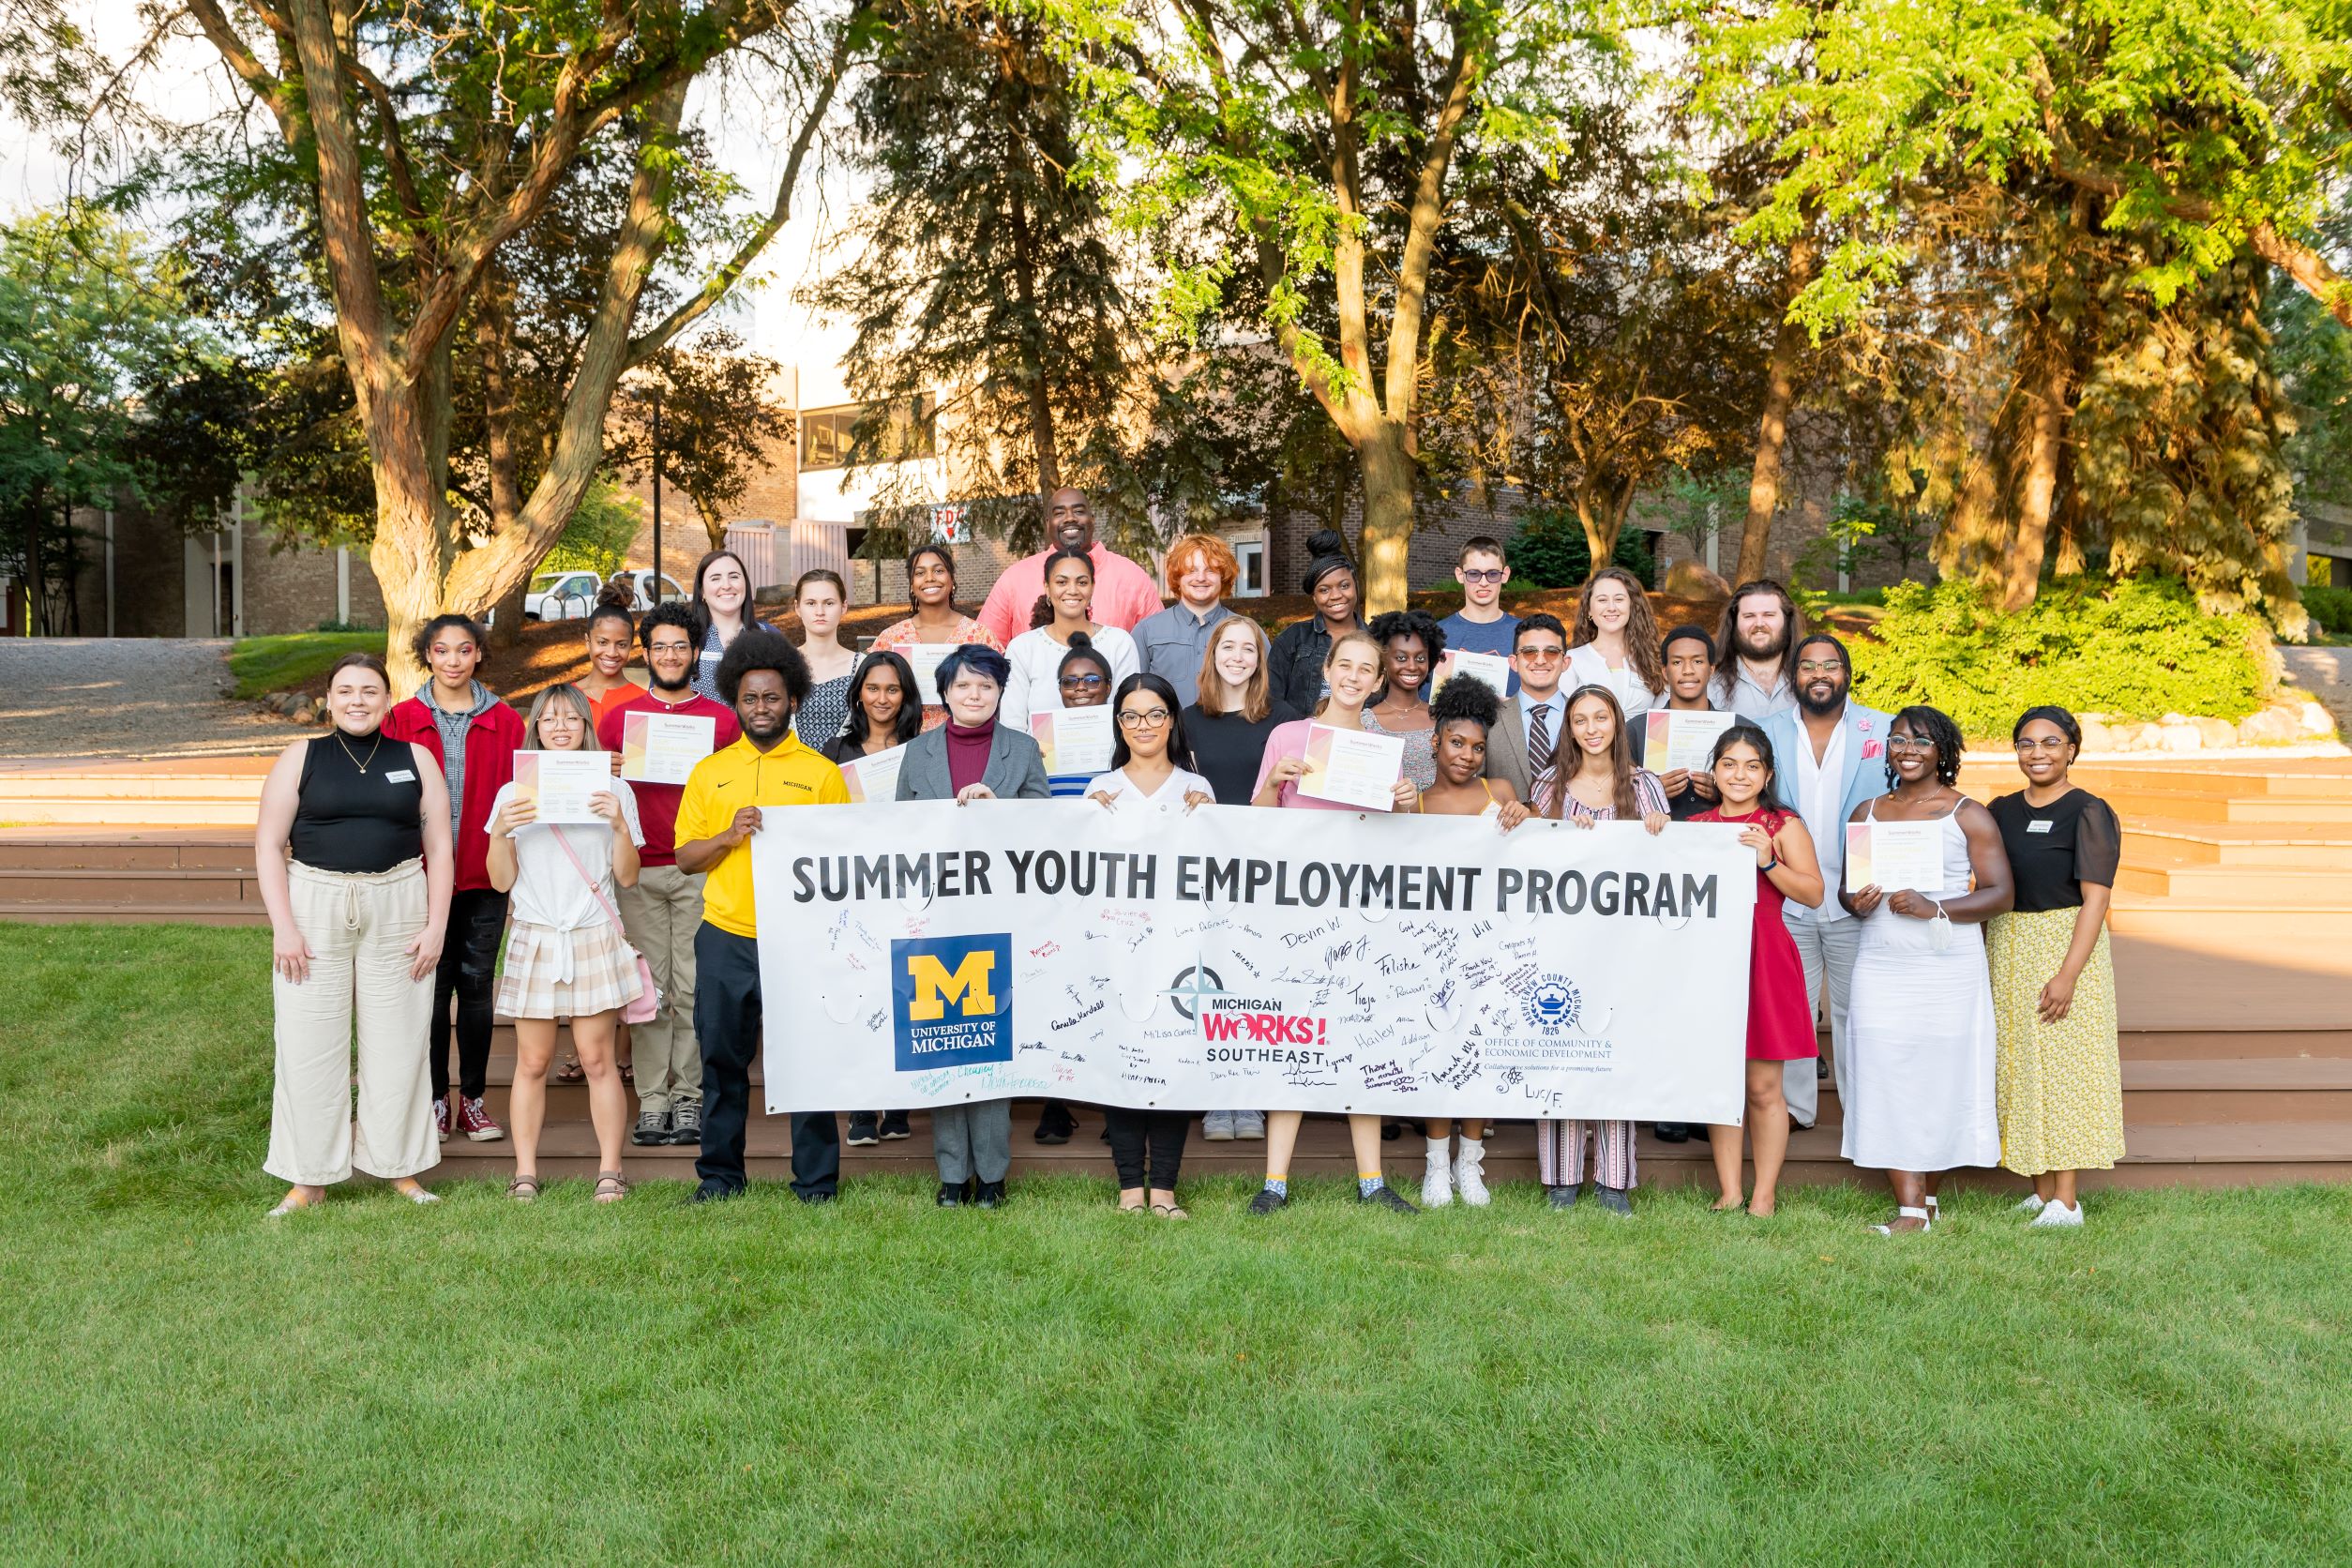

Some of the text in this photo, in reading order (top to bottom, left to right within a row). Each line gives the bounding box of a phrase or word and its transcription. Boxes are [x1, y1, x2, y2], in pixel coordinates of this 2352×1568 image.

[792, 850, 1719, 919] SUMMER YOUTH EMPLOYMENT PROGRAM
[1472, 920, 1493, 938] Will
[1374, 953, 1422, 977] Felisha
[1459, 961, 1481, 972] Thank
[908, 950, 996, 1021] M
[1212, 998, 1282, 1012] MICHIGAN
[1520, 979, 1538, 1029] WASHTENAW
[1541, 972, 1574, 988] COUNTY
[1564, 988, 1582, 1029] MICHIGAN
[911, 1020, 996, 1038] UNIVERSITY OF
[1354, 1024, 1395, 1050] Hailey
[911, 1033, 996, 1055] MICHIGAN
[1485, 1038, 1520, 1047] OFFICE
[1522, 1039, 1535, 1048] OF
[1538, 1039, 1603, 1048] COMMUNITY
[1207, 1048, 1325, 1065] SOUTHEAST
[1485, 1048, 1612, 1059] ECONOMIC DEVELOPMENT
[1360, 1063, 1387, 1077] Thank
